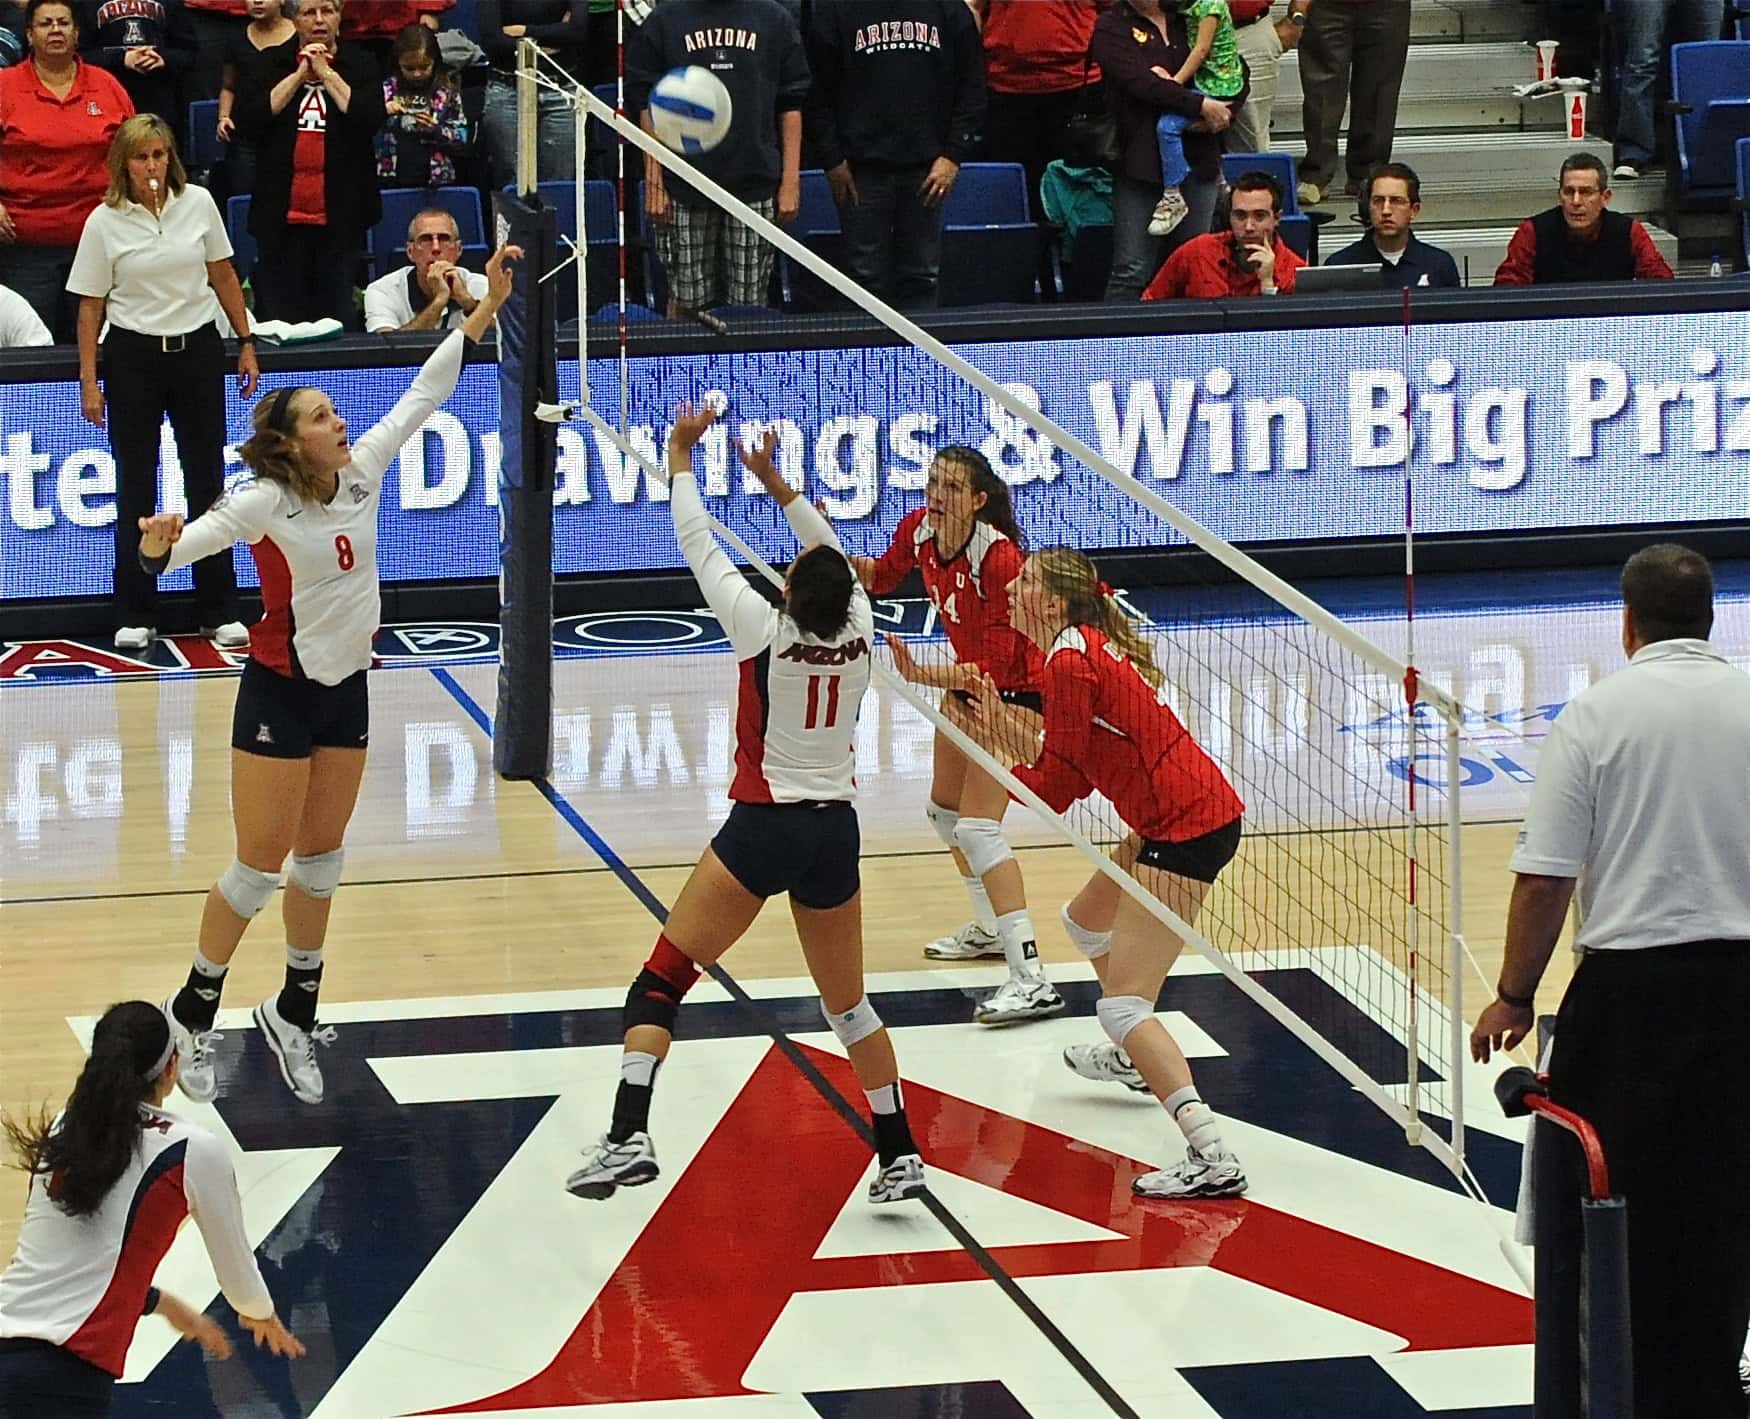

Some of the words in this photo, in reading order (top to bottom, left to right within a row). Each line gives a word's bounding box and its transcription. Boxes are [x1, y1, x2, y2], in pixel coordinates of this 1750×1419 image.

[684, 28, 757, 52] ARIZONA
[854, 21, 940, 51] ARIZONA
[866, 43, 931, 54] WILDCATS
[979, 382, 1061, 486] &
[1088, 366, 1308, 480] Win
[1348, 357, 1530, 492] Big
[334, 535, 355, 571] 8
[956, 571, 965, 589] U
[805, 675, 841, 730] 11
